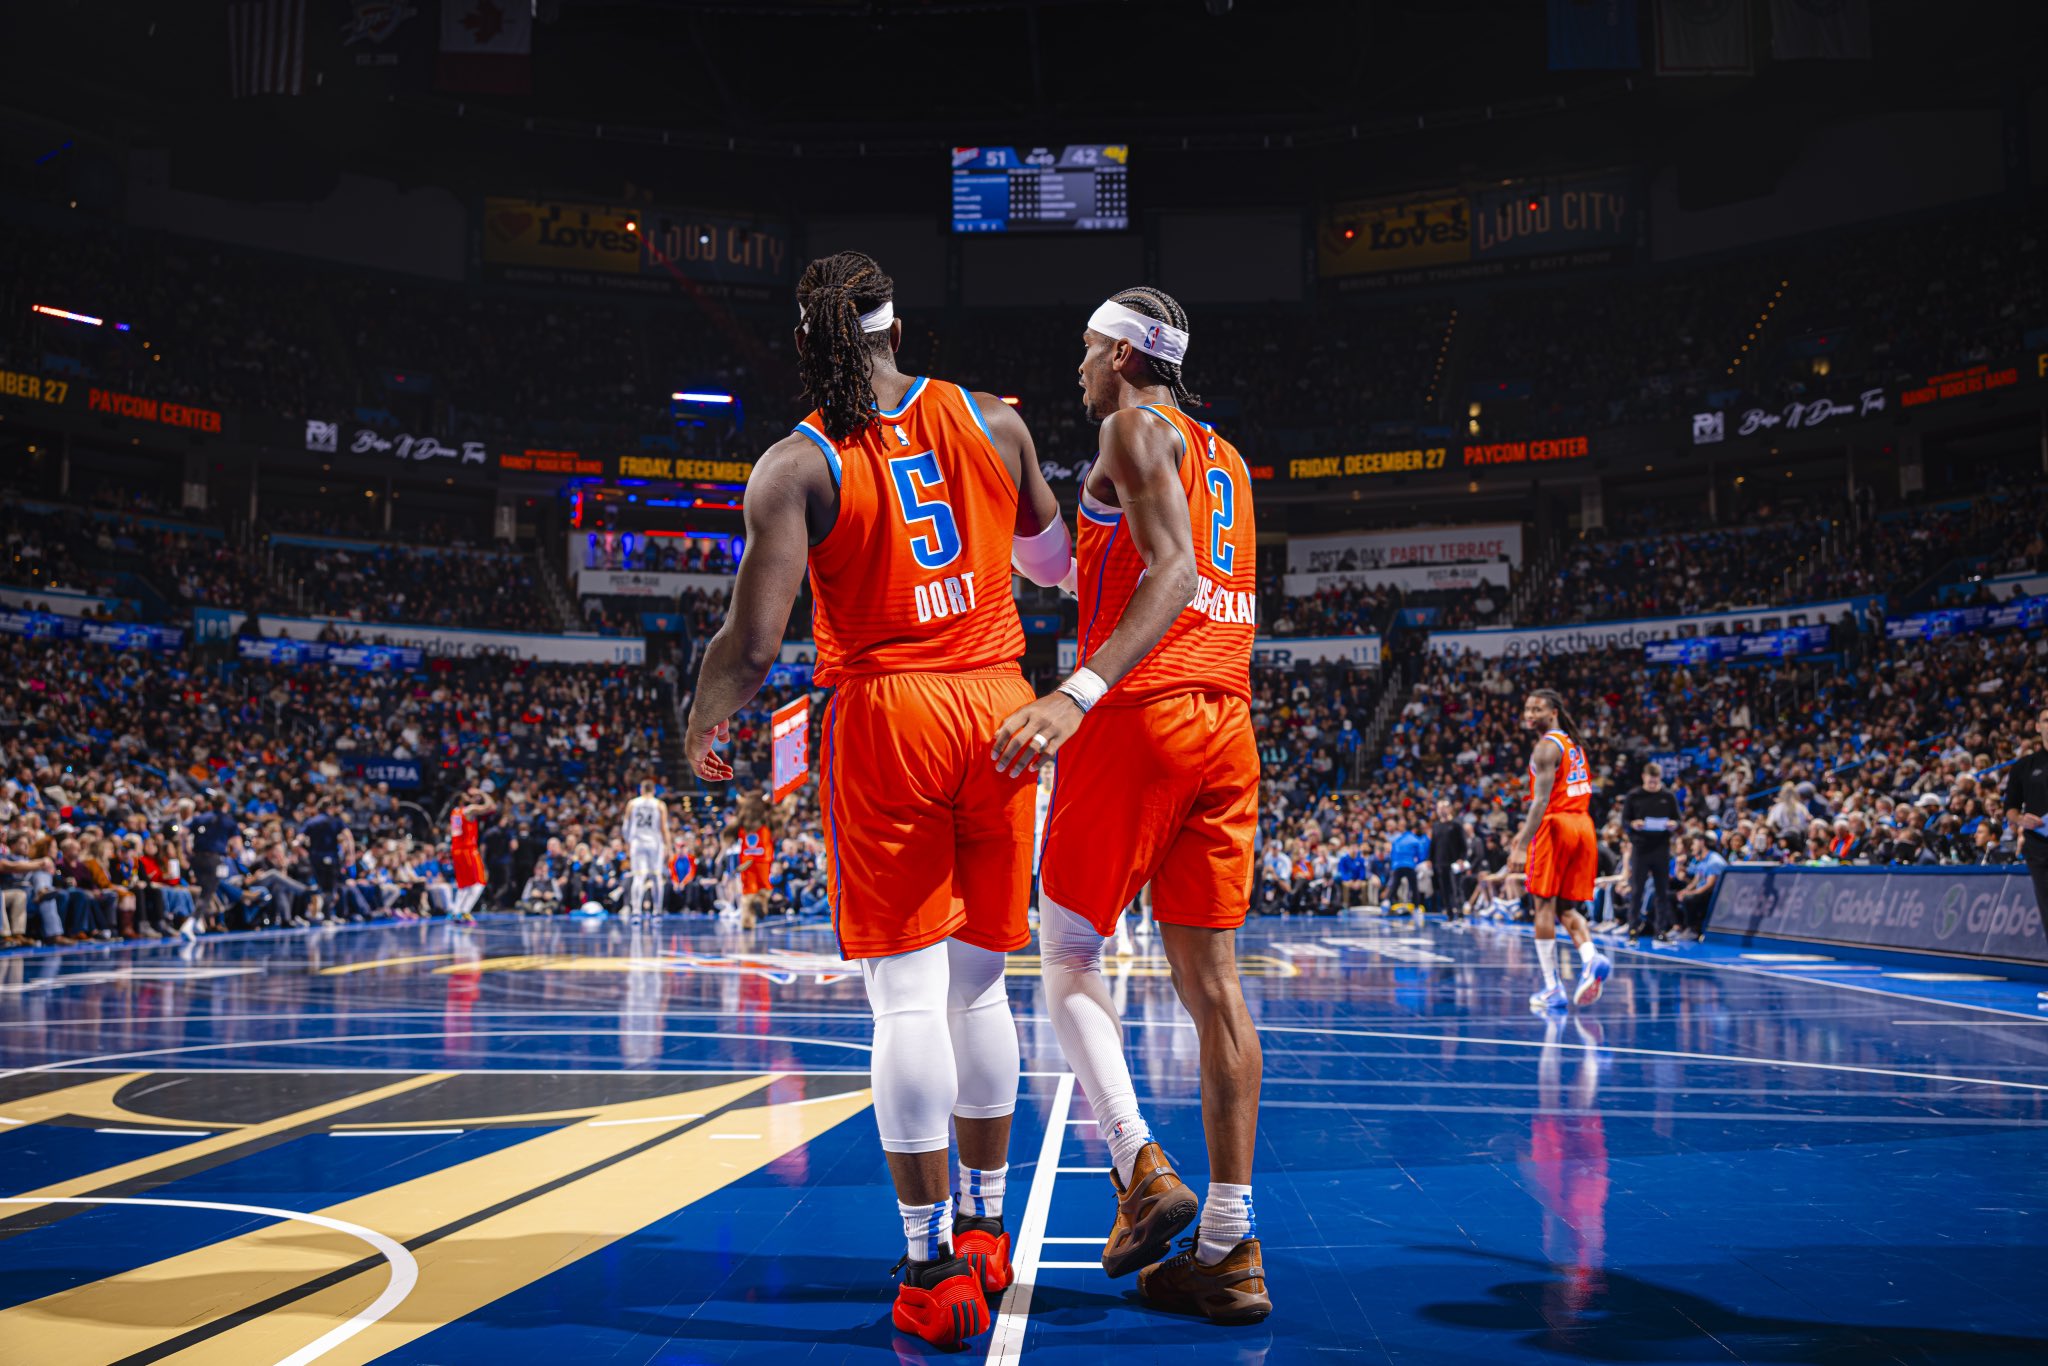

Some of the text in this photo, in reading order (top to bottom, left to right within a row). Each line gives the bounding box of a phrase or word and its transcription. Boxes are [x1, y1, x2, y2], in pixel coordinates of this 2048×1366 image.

[986, 151, 1006, 166] 51
[1072, 148, 1098, 165] 42
[1478, 195, 1551, 251] LOUD
[1562, 191, 1628, 233] CITY
[648, 223, 785, 277] LOUD CITY
[45, 379, 68, 404] 27
[89, 388, 158, 422] PAYCOM
[160, 401, 222, 433] CENTER
[619, 455, 752, 482] FRIDAY, DECEMBER
[1289, 436, 1589, 480] FRIDAY, DECEMBER 27 PAYCOM CENTER
[888, 450, 963, 570] 5
[1207, 467, 1235, 577] 2
[1391, 545, 1435, 563] PARTY
[1440, 540, 1505, 561] TERRACE
[914, 572, 977, 623] DORT
[1353, 646, 1379, 661] 111
[1504, 626, 1661, 655] @okcthunder
[366, 765, 419, 782] ULTRA
[636, 812, 653, 829] 24
[1733, 884, 1776, 918] Globe
[1832, 888, 1925, 929] Globe Life
[1967, 892, 2041, 937] Globe
